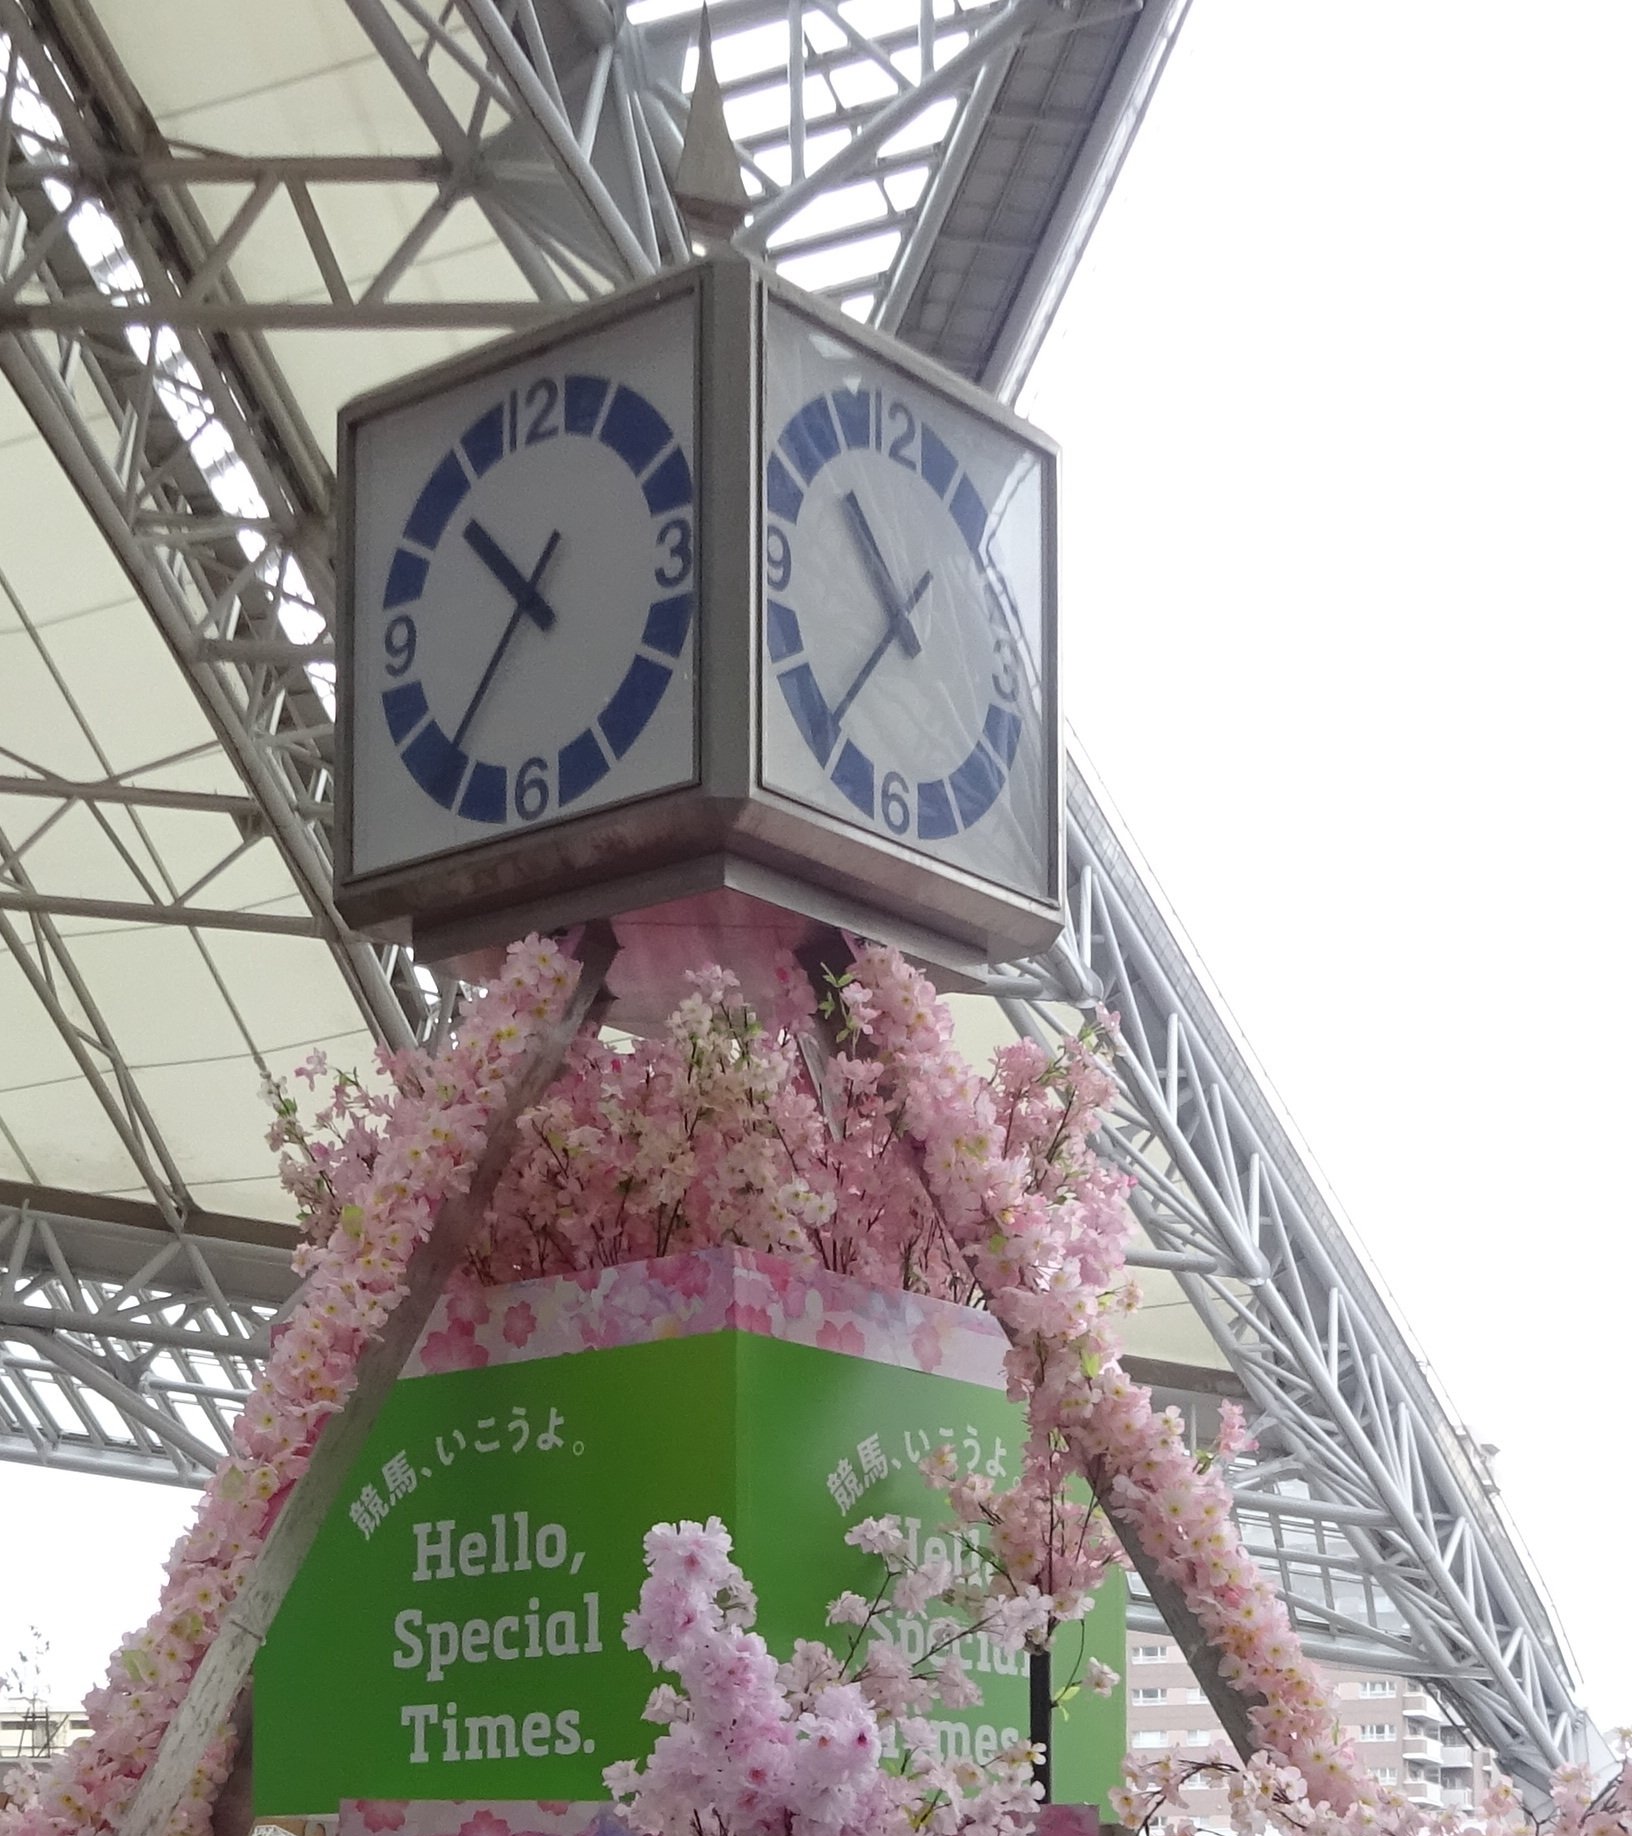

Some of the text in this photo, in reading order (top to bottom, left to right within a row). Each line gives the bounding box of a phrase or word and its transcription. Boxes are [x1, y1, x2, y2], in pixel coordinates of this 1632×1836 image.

[509, 376, 559, 454] 12
[875, 387, 918, 471] 12
[654, 518, 693, 588] 3
[767, 525, 792, 592] 9
[383, 614, 417, 677] 9
[514, 756, 550, 822] 6
[881, 771, 910, 836] 6
[349, 1406, 586, 1541] 競馬、いこうよ。
[412, 1511, 586, 1583] Hello,
[393, 1592, 603, 1682] Special
[401, 1702, 596, 1763] Times.
